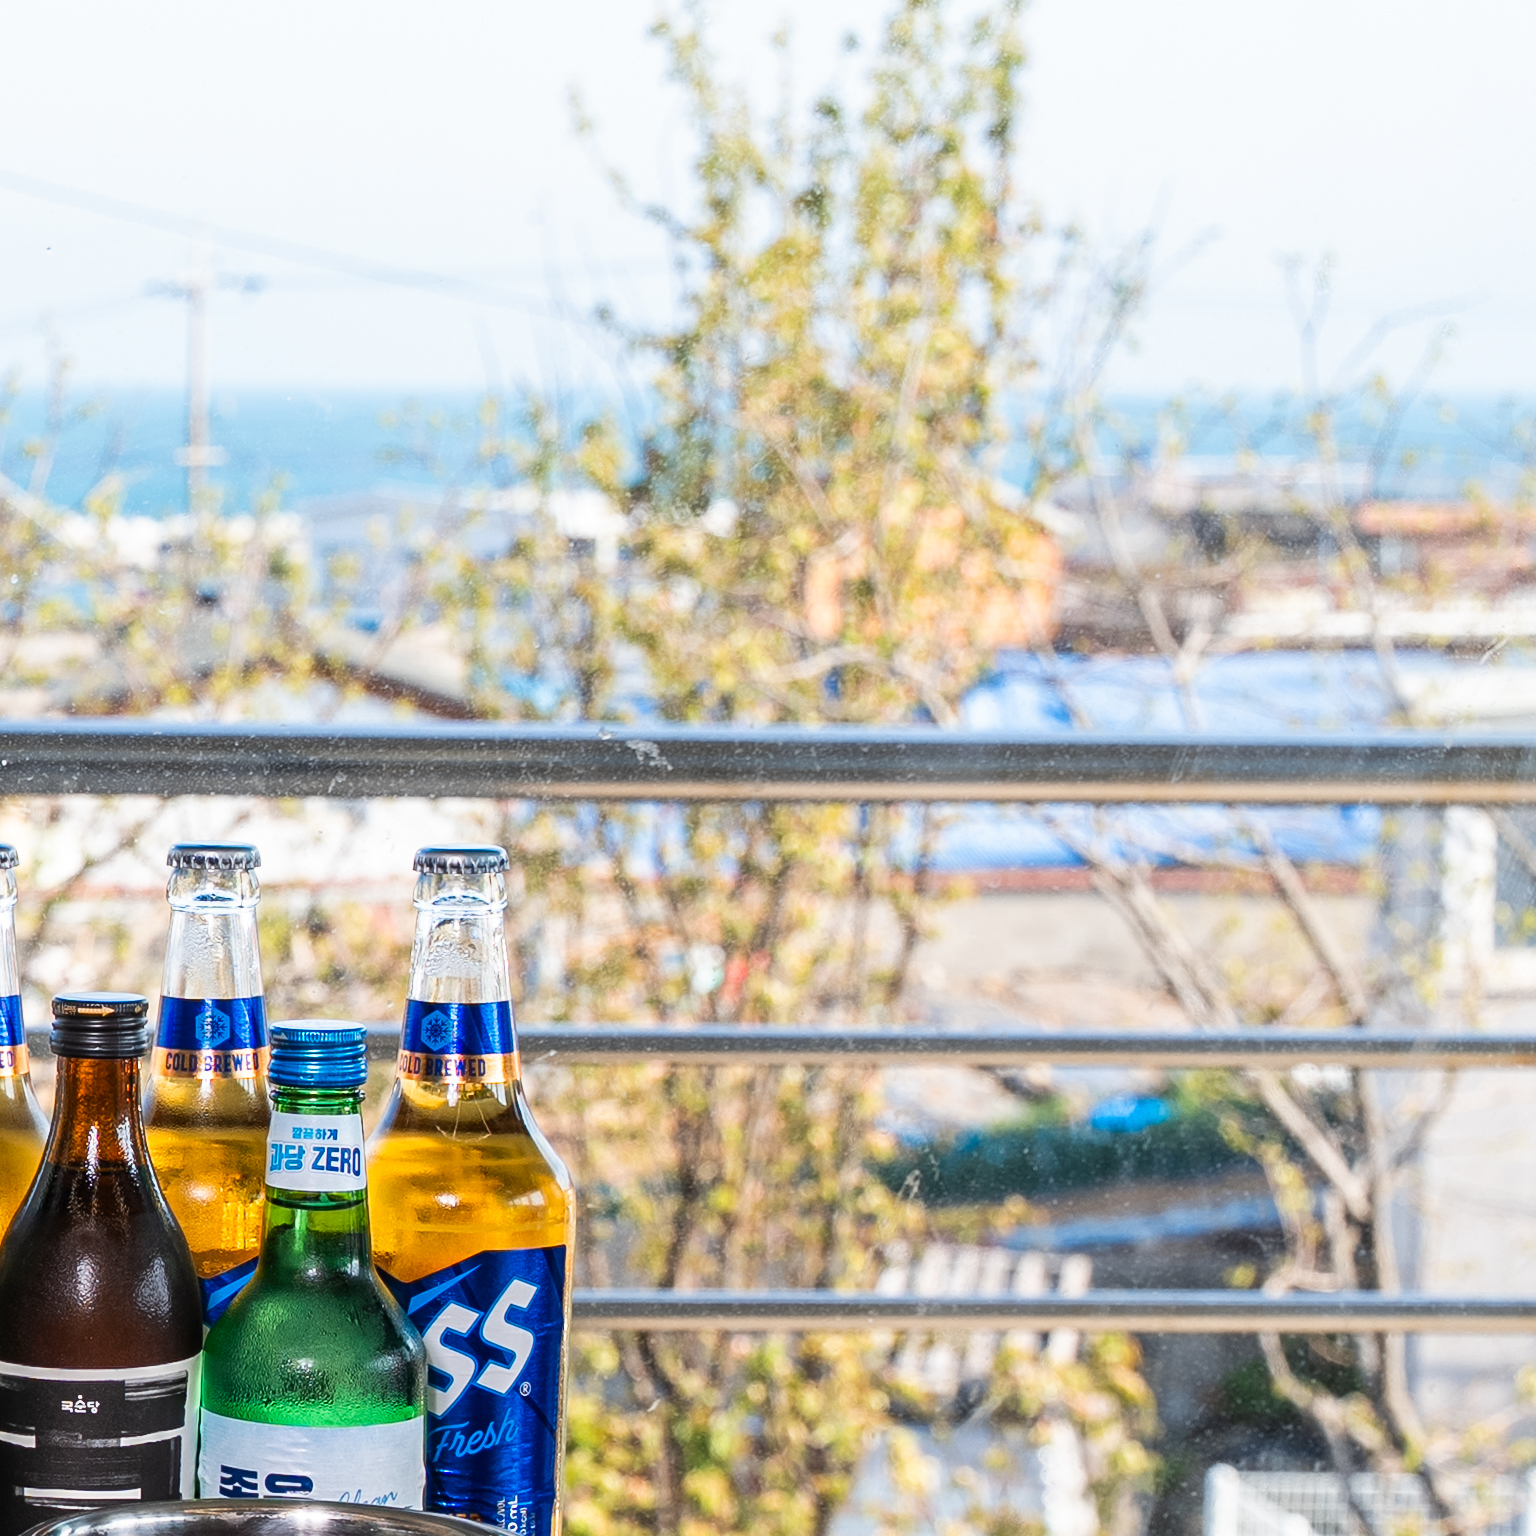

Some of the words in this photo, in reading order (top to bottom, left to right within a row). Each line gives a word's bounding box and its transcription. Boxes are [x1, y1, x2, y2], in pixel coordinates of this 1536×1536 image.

[166, 1052, 198, 1071] COLD
[203, 1051, 260, 1073] BREWED
[399, 1053, 422, 1075] COLD
[427, 1056, 487, 1078] BREWED
[270, 1142, 306, 1173] 과당
[312, 1146, 362, 1177] ZERO
[60, 1394, 101, 1414] 국순당
[430, 1408, 520, 1462] Fresh
